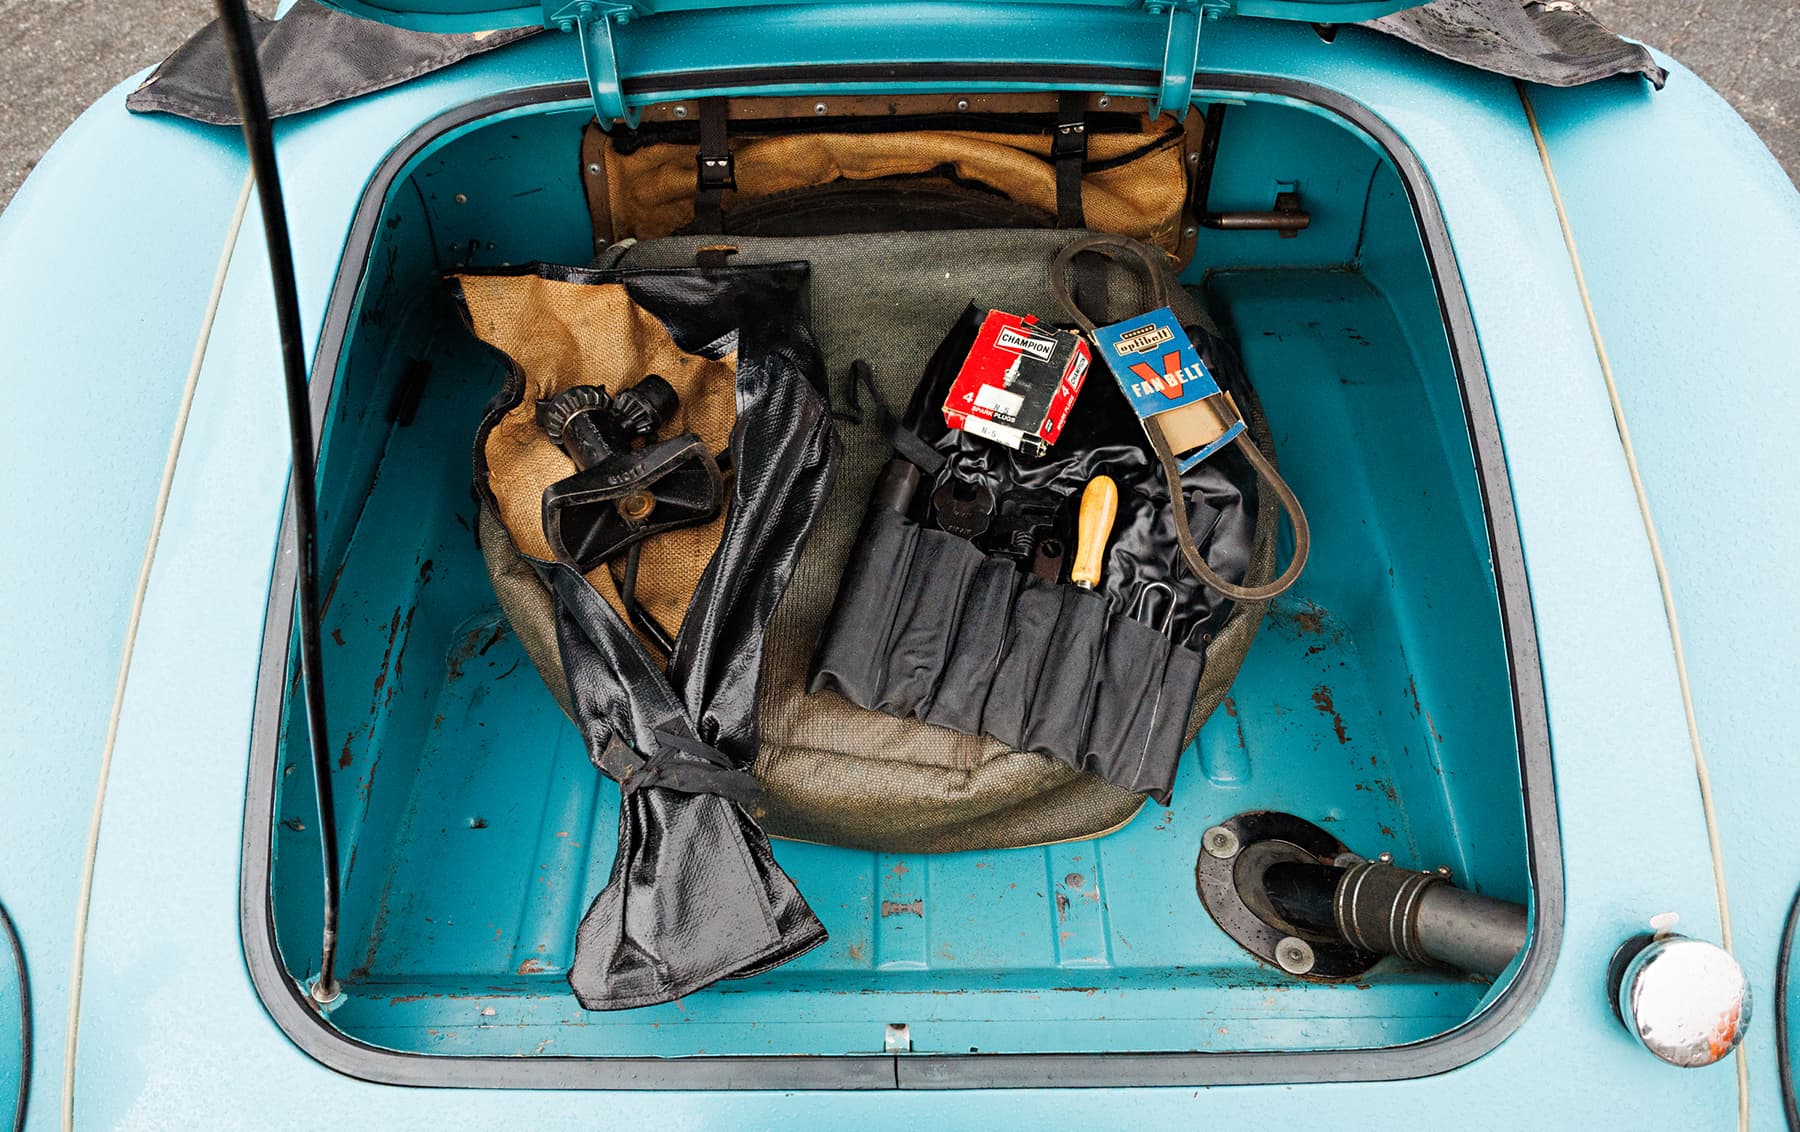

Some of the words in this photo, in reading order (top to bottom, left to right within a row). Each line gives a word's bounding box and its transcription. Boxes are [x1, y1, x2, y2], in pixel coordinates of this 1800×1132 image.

[1001, 333, 1050, 354] CHAMPION
[1120, 329, 1168, 353] optibelt
[1070, 358, 1085, 385] CHAMPION
[1128, 350, 1184, 400] V
[1131, 376, 1166, 398] FAN
[1163, 363, 1205, 388] BELT
[962, 391, 975, 404] 4
[1062, 384, 1070, 397] 4
[971, 405, 995, 417] SPARK
[993, 411, 1016, 423] PLUGS
